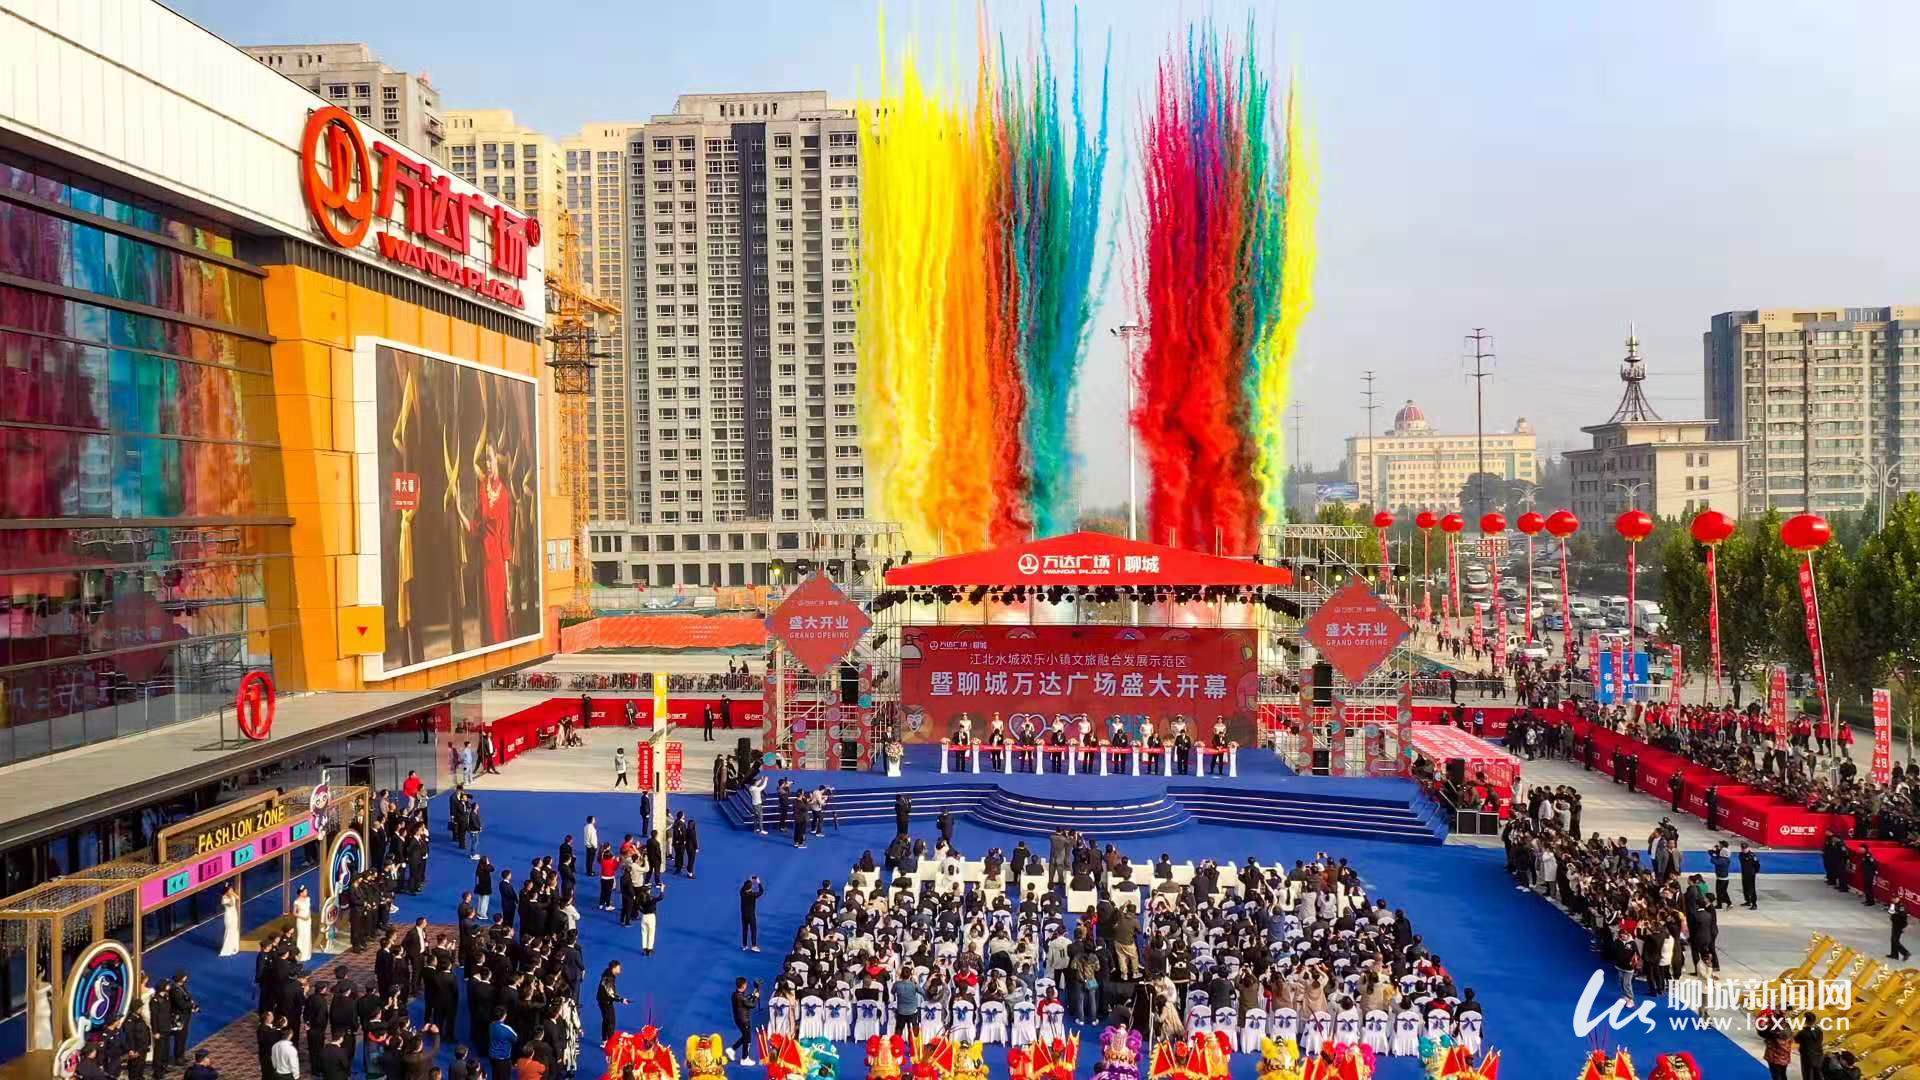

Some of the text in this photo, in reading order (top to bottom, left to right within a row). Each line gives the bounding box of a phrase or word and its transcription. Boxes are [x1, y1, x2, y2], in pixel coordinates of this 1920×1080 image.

[373, 141, 527, 280] 万达广场
[376, 231, 526, 310] WANDA PLAZA
[1042, 554, 1160, 573] 万达广场 聊城
[789, 616, 849, 629] 盛大开业
[1326, 622, 1388, 636] 盛大开业
[789, 631, 849, 639] GRAND OPENING
[1326, 639, 1388, 647] GRAND OPENING
[969, 653, 1187, 668] 江北水城欢乐小镇文旅融合发展示范区
[930, 671, 1227, 699] 暨聊城万达广场盛大开幕
[198, 805, 284, 854] FASHION ZONE
